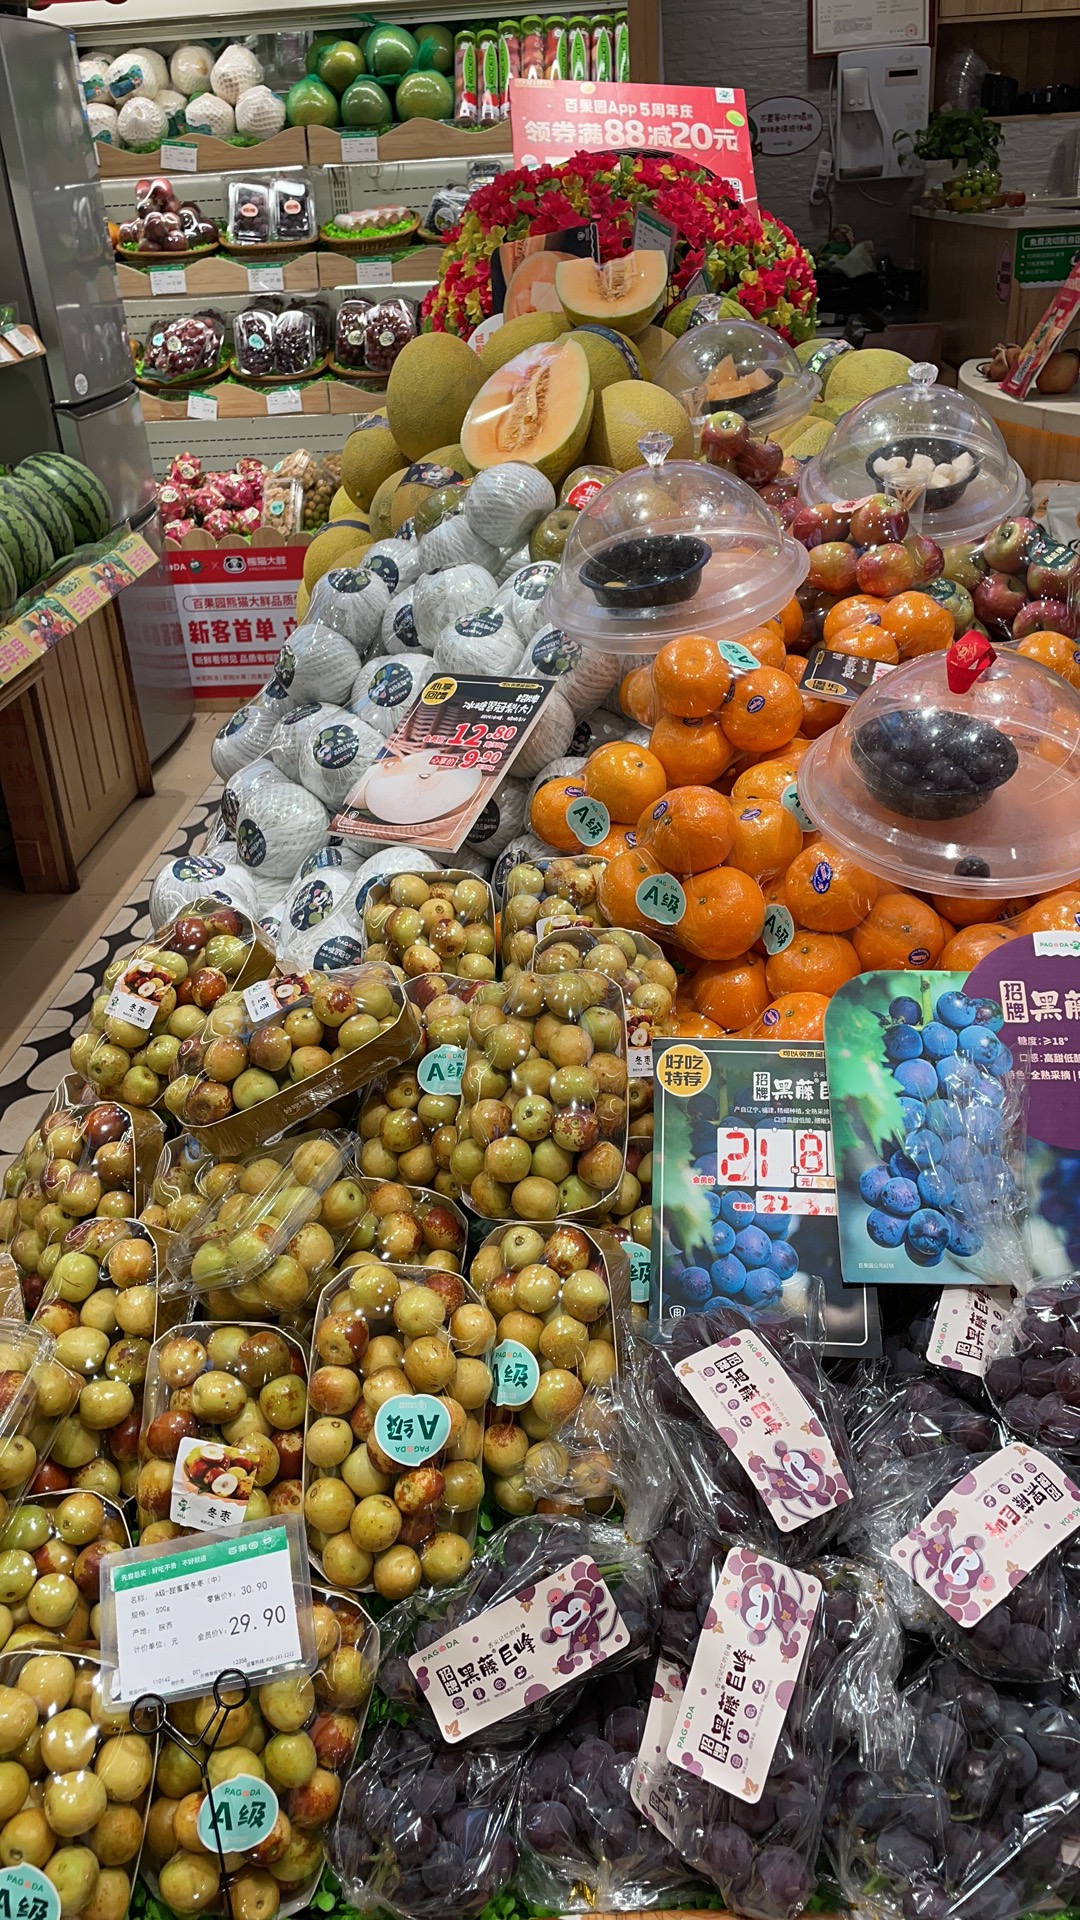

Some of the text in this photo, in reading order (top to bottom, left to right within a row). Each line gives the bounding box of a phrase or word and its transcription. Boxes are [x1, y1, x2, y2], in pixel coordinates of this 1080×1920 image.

[524, 119, 738, 152] 领券满88减20元
[188, 617, 277, 644] 新客首单
[448, 722, 517, 747] 12.80
[462, 749, 502, 769] 9.90
[573, 806, 603, 839] A级
[643, 885, 680, 914] A级
[765, 914, 789, 947] A级
[434, 1051, 462, 1059] PAGODA
[635, 1055, 652, 1065] 冬枣
[665, 1054, 704, 1070] 好吃
[664, 1071, 703, 1087] 特荐
[756, 1073, 769, 1099] 招牌
[692, 1176, 716, 1185] 会员价
[734, 1202, 754, 1211] 零售价
[935, 1322, 949, 1354] PAGODA
[495, 1352, 523, 1360] PAGODA
[744, 1339, 770, 1368] PAGODA
[387, 1414, 440, 1442] A级
[395, 1445, 431, 1453] PAGODA
[208, 1506, 232, 1522] 冬枣
[151, 1562, 177, 1575] 好吃不贵
[181, 1554, 207, 1567] 不好就退
[241, 1581, 268, 1595] 30.90
[156, 1606, 171, 1614] 500g
[229, 1605, 286, 1636] 29.90
[171, 1637, 179, 1646] 元
[422, 1638, 460, 1663] PAGODA
[676, 1705, 696, 1749] PAGODA
[224, 1788, 262, 1798] PAGODA
[208, 1801, 267, 1831] A级
[6, 1874, 44, 1893] PAGODA
[0, 1887, 49, 1920] A级
